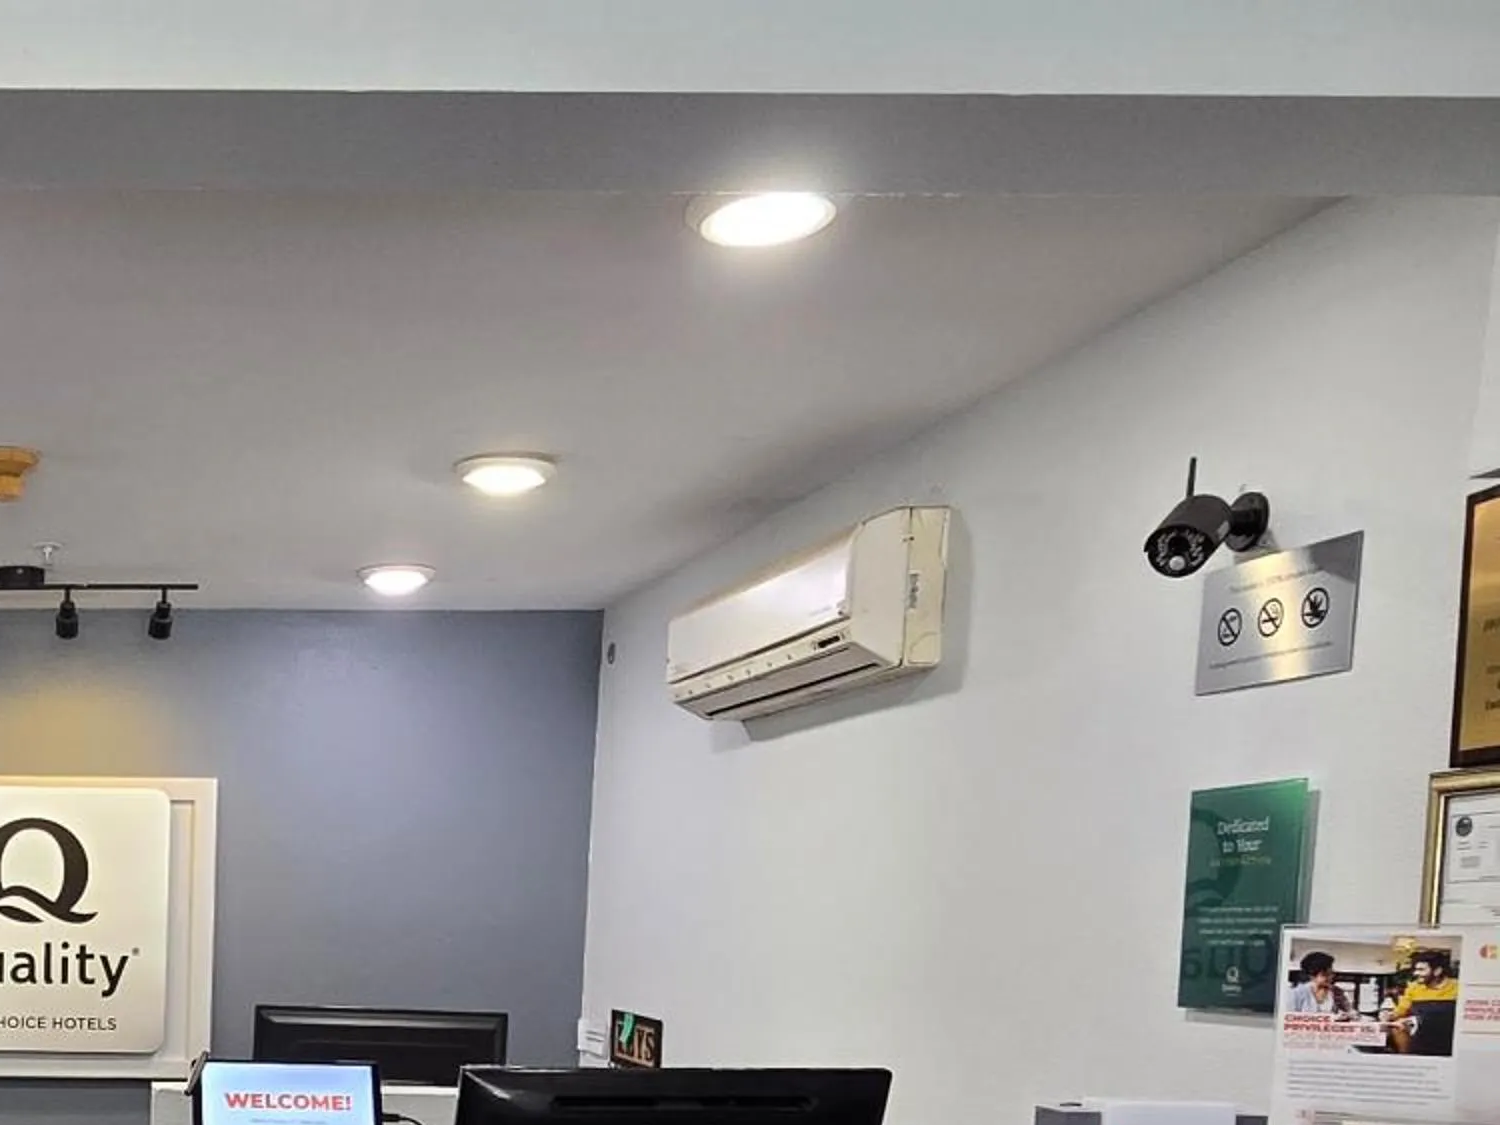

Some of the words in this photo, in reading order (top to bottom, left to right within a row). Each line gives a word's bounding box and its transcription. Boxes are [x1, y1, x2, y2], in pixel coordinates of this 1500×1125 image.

[52, 1017, 117, 1031] HOTELS
[1284, 1013, 1331, 1022] CHOICE
[224, 1092, 352, 1111] WELCOME!
